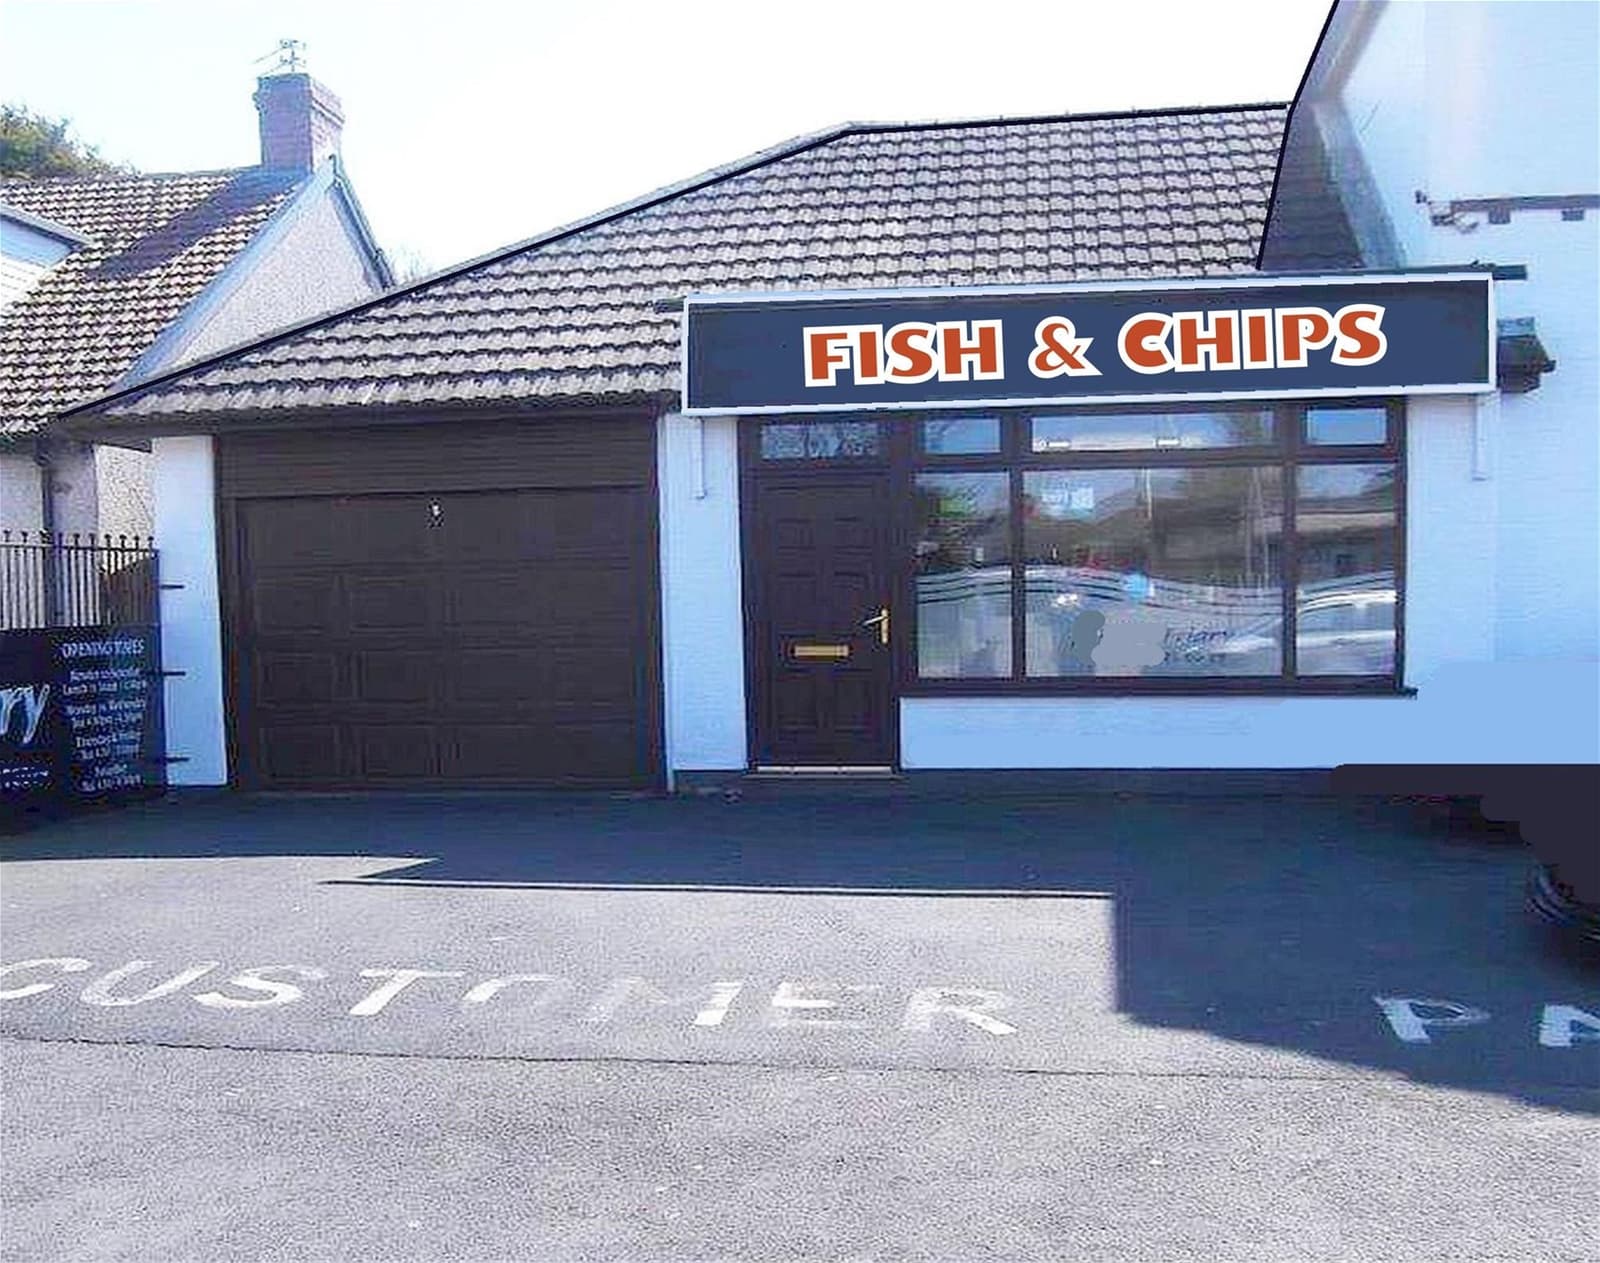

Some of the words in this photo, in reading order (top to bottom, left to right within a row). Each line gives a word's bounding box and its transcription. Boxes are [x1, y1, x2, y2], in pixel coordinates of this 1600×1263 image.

[803, 318, 1004, 388] FISH
[1028, 315, 1102, 379] &
[1117, 303, 1388, 374] CHIPS
